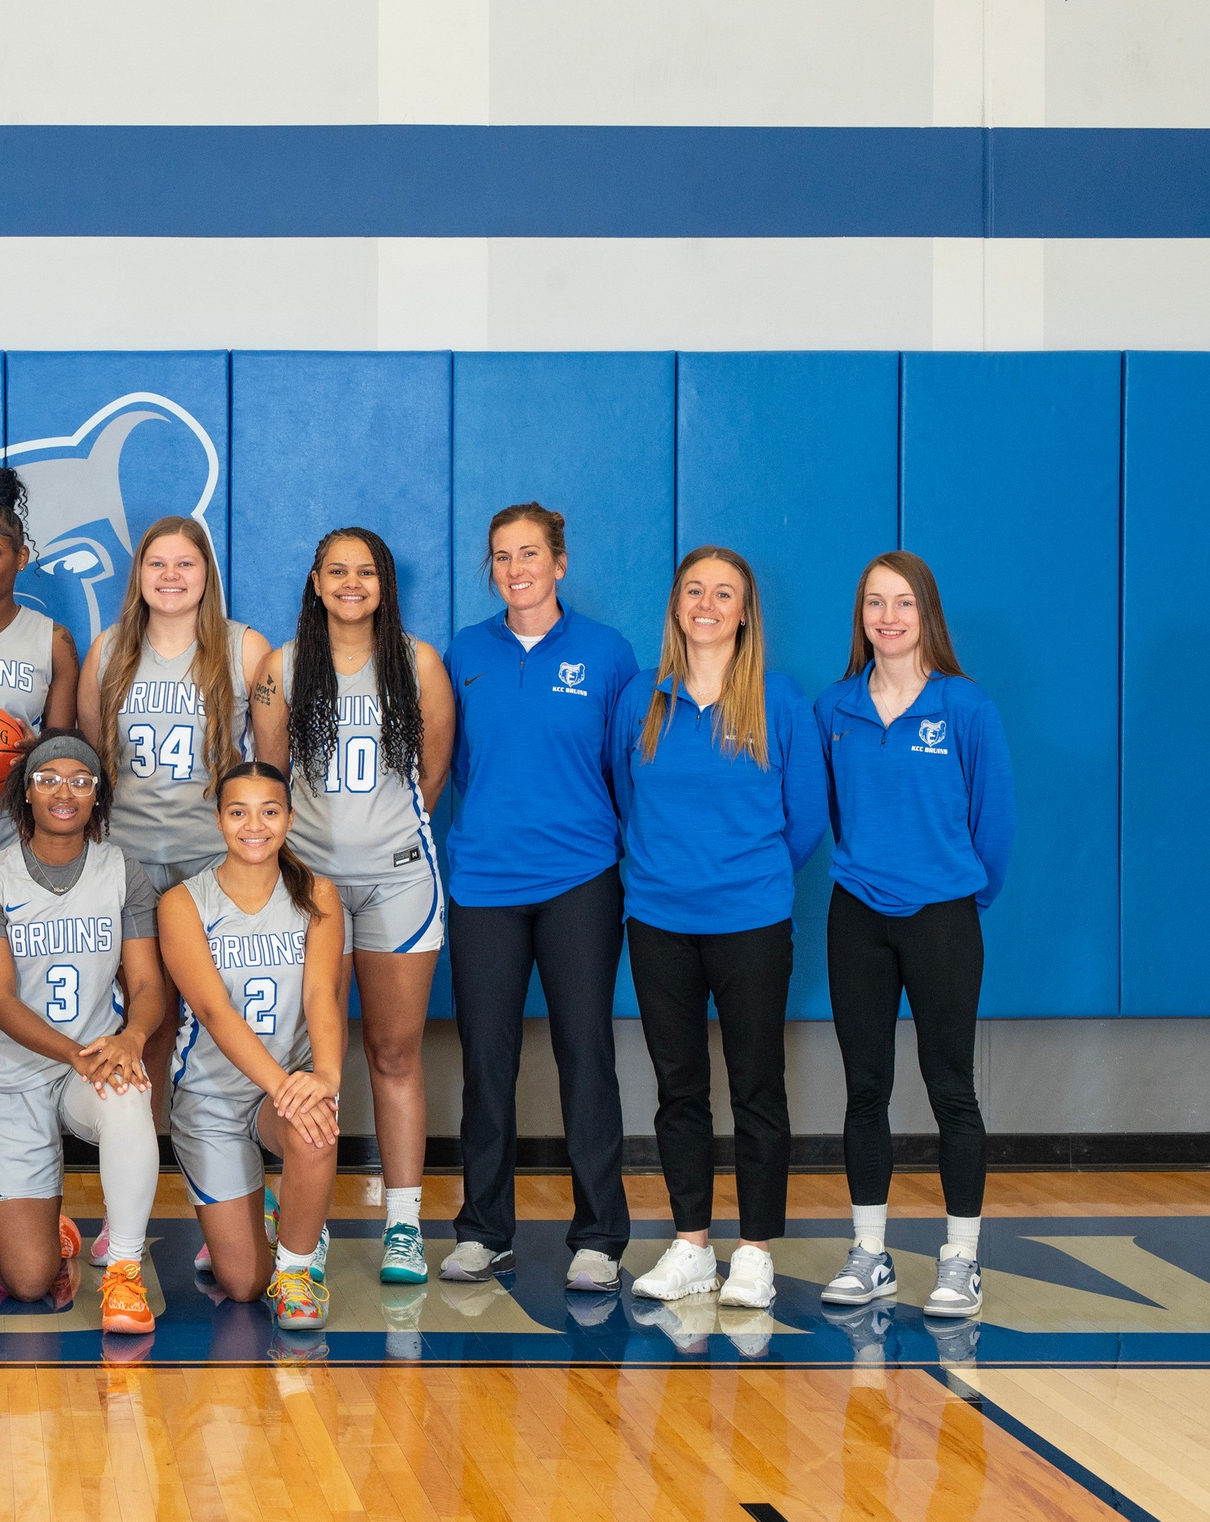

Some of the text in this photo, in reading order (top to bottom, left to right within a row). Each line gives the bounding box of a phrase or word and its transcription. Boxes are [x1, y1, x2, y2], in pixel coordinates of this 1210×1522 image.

[565, 687, 588, 697] BRUINS
[128, 724, 194, 780] 34
[323, 736, 378, 793] 10
[924, 746, 948, 755] BRUINS
[10, 917, 112, 957] BRUINS
[207, 930, 305, 970] BRUINS
[46, 964, 79, 1023] 3
[244, 977, 277, 1035] 2
